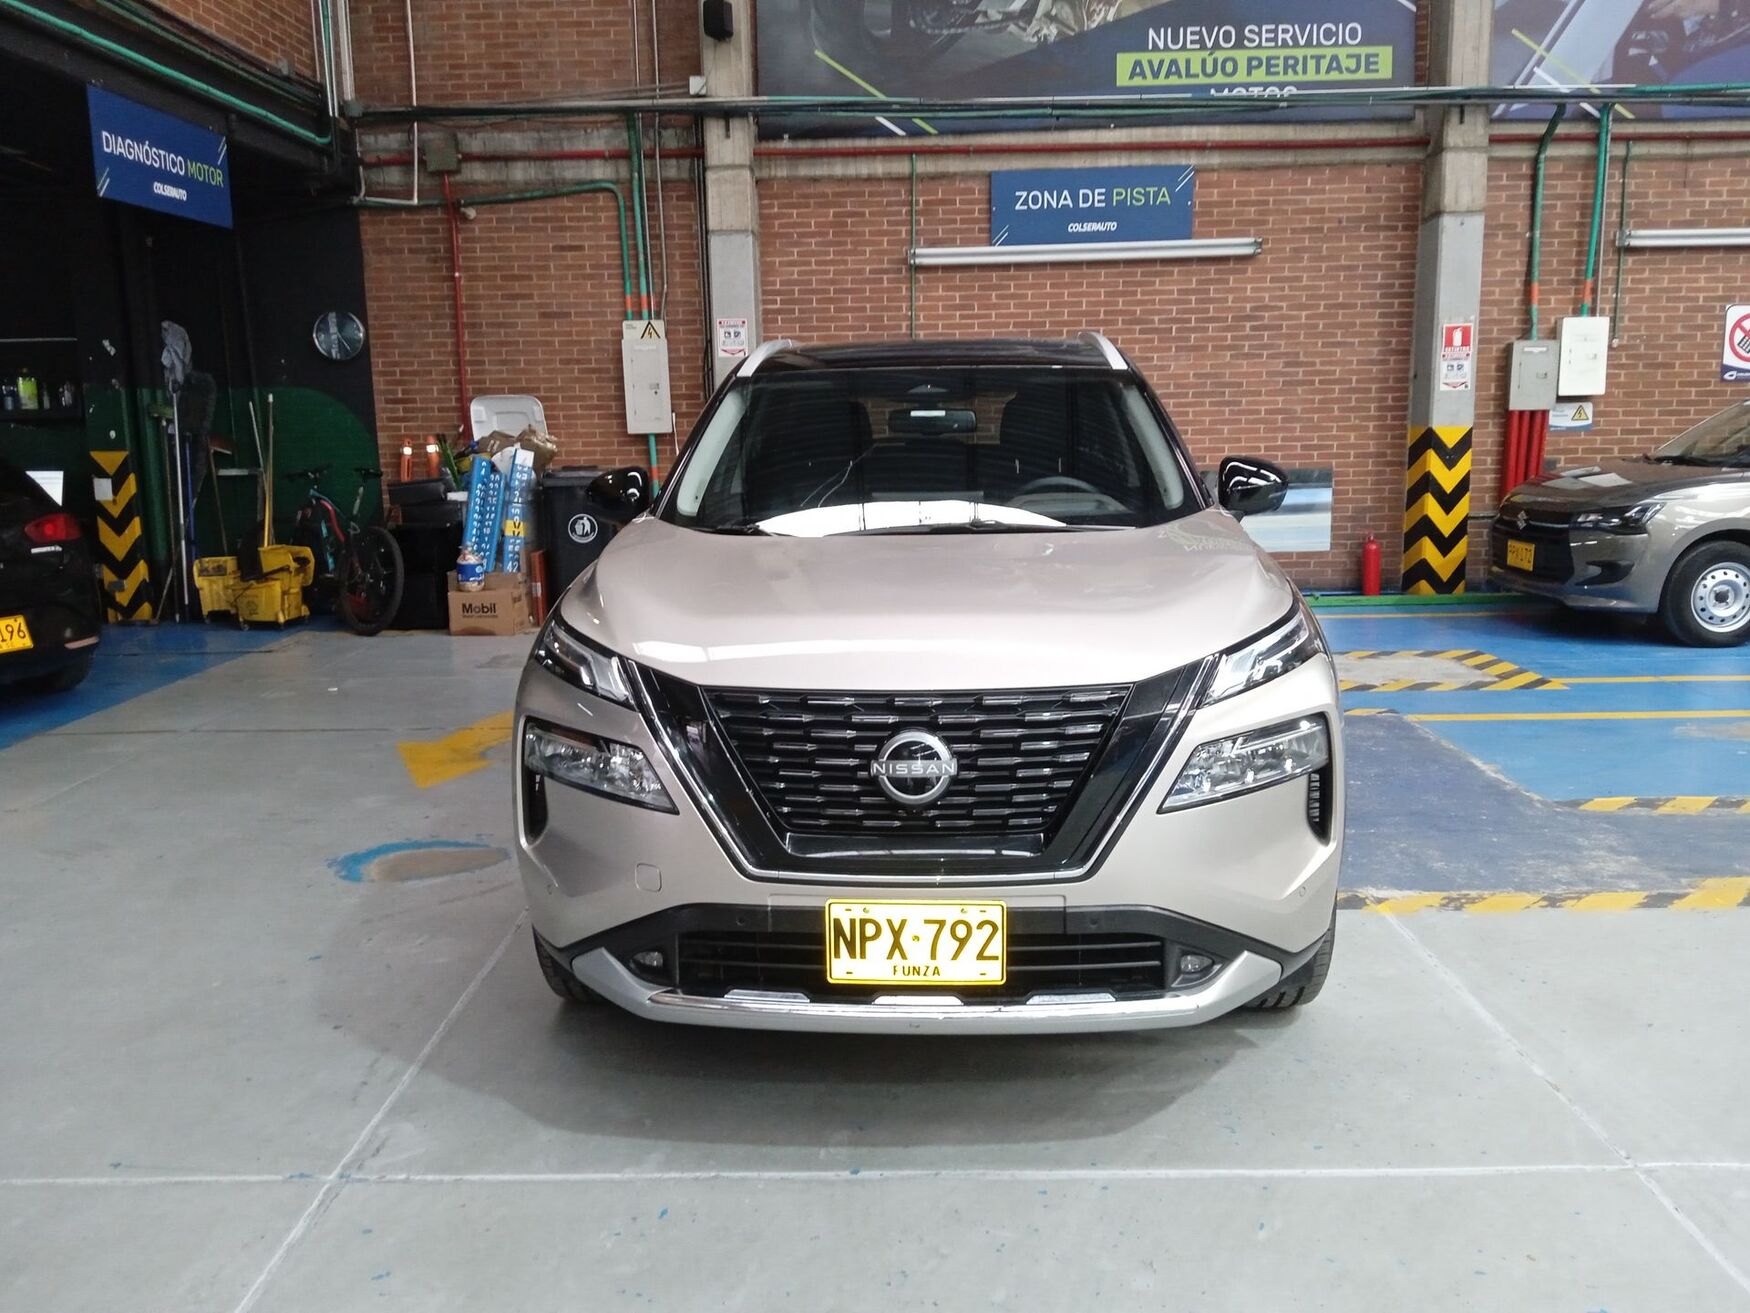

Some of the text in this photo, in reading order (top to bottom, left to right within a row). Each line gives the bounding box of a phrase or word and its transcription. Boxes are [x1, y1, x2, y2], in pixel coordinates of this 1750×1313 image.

[1148, 22, 1363, 51] NUEVO SERVICIO
[1128, 50, 1380, 81] AVALÚO PERITAJE
[101, 130, 224, 188] DIAGNÓSTICO MOTOR
[1014, 186, 1172, 211] ZONA DE PISTA
[1067, 221, 1118, 233] COLSERAUTO
[462, 603, 497, 614] Mobil
[873, 762, 955, 775] NISSAN
[893, 964, 941, 977] FUNZA
